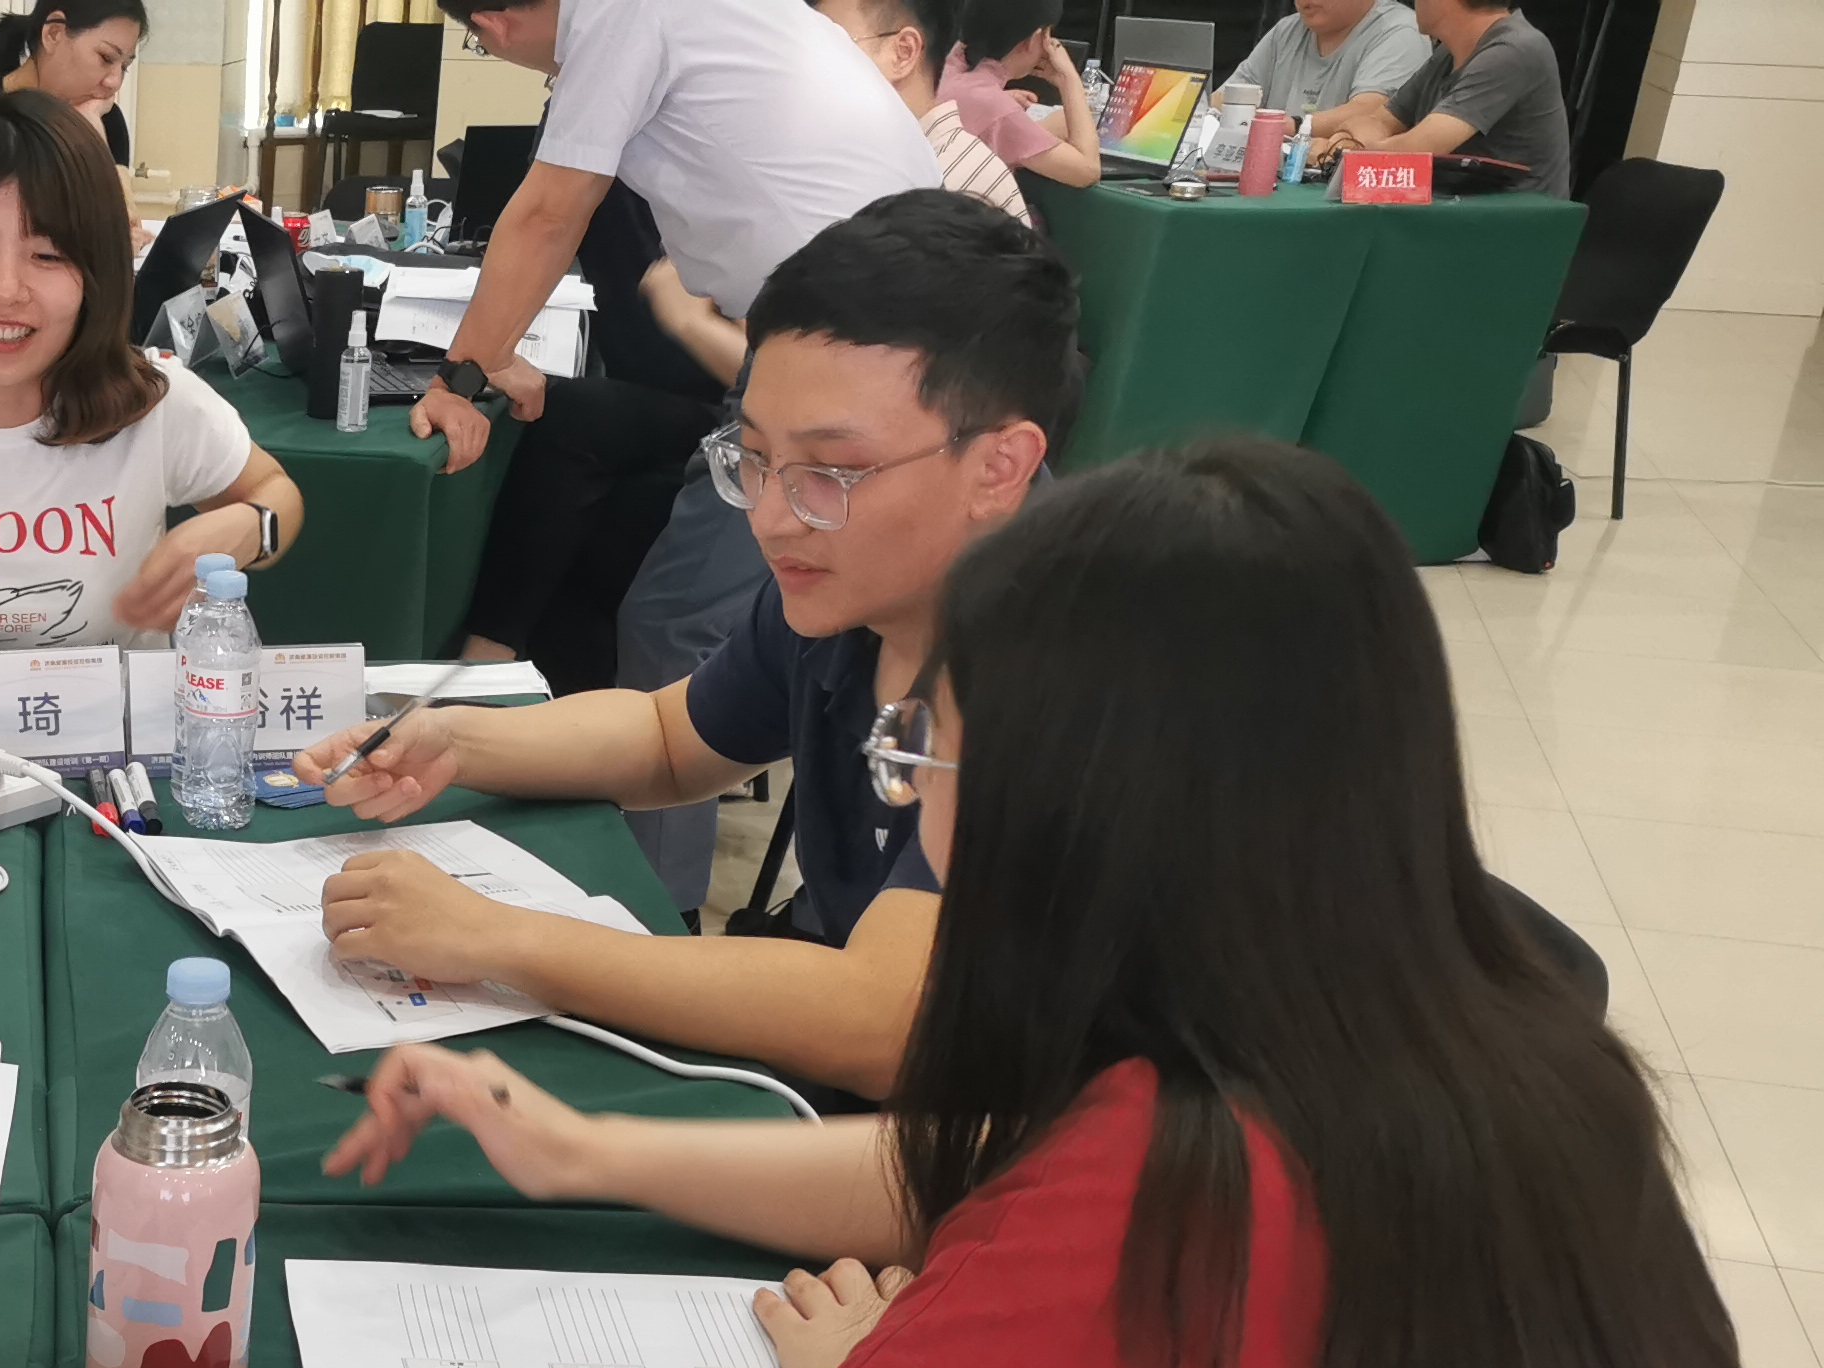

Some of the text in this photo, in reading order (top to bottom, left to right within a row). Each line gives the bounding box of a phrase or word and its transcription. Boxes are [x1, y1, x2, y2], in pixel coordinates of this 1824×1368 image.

[1356, 165, 1416, 189] 第五组
[11, 611, 47, 623] SEEN
[186, 670, 224, 690] LEASE
